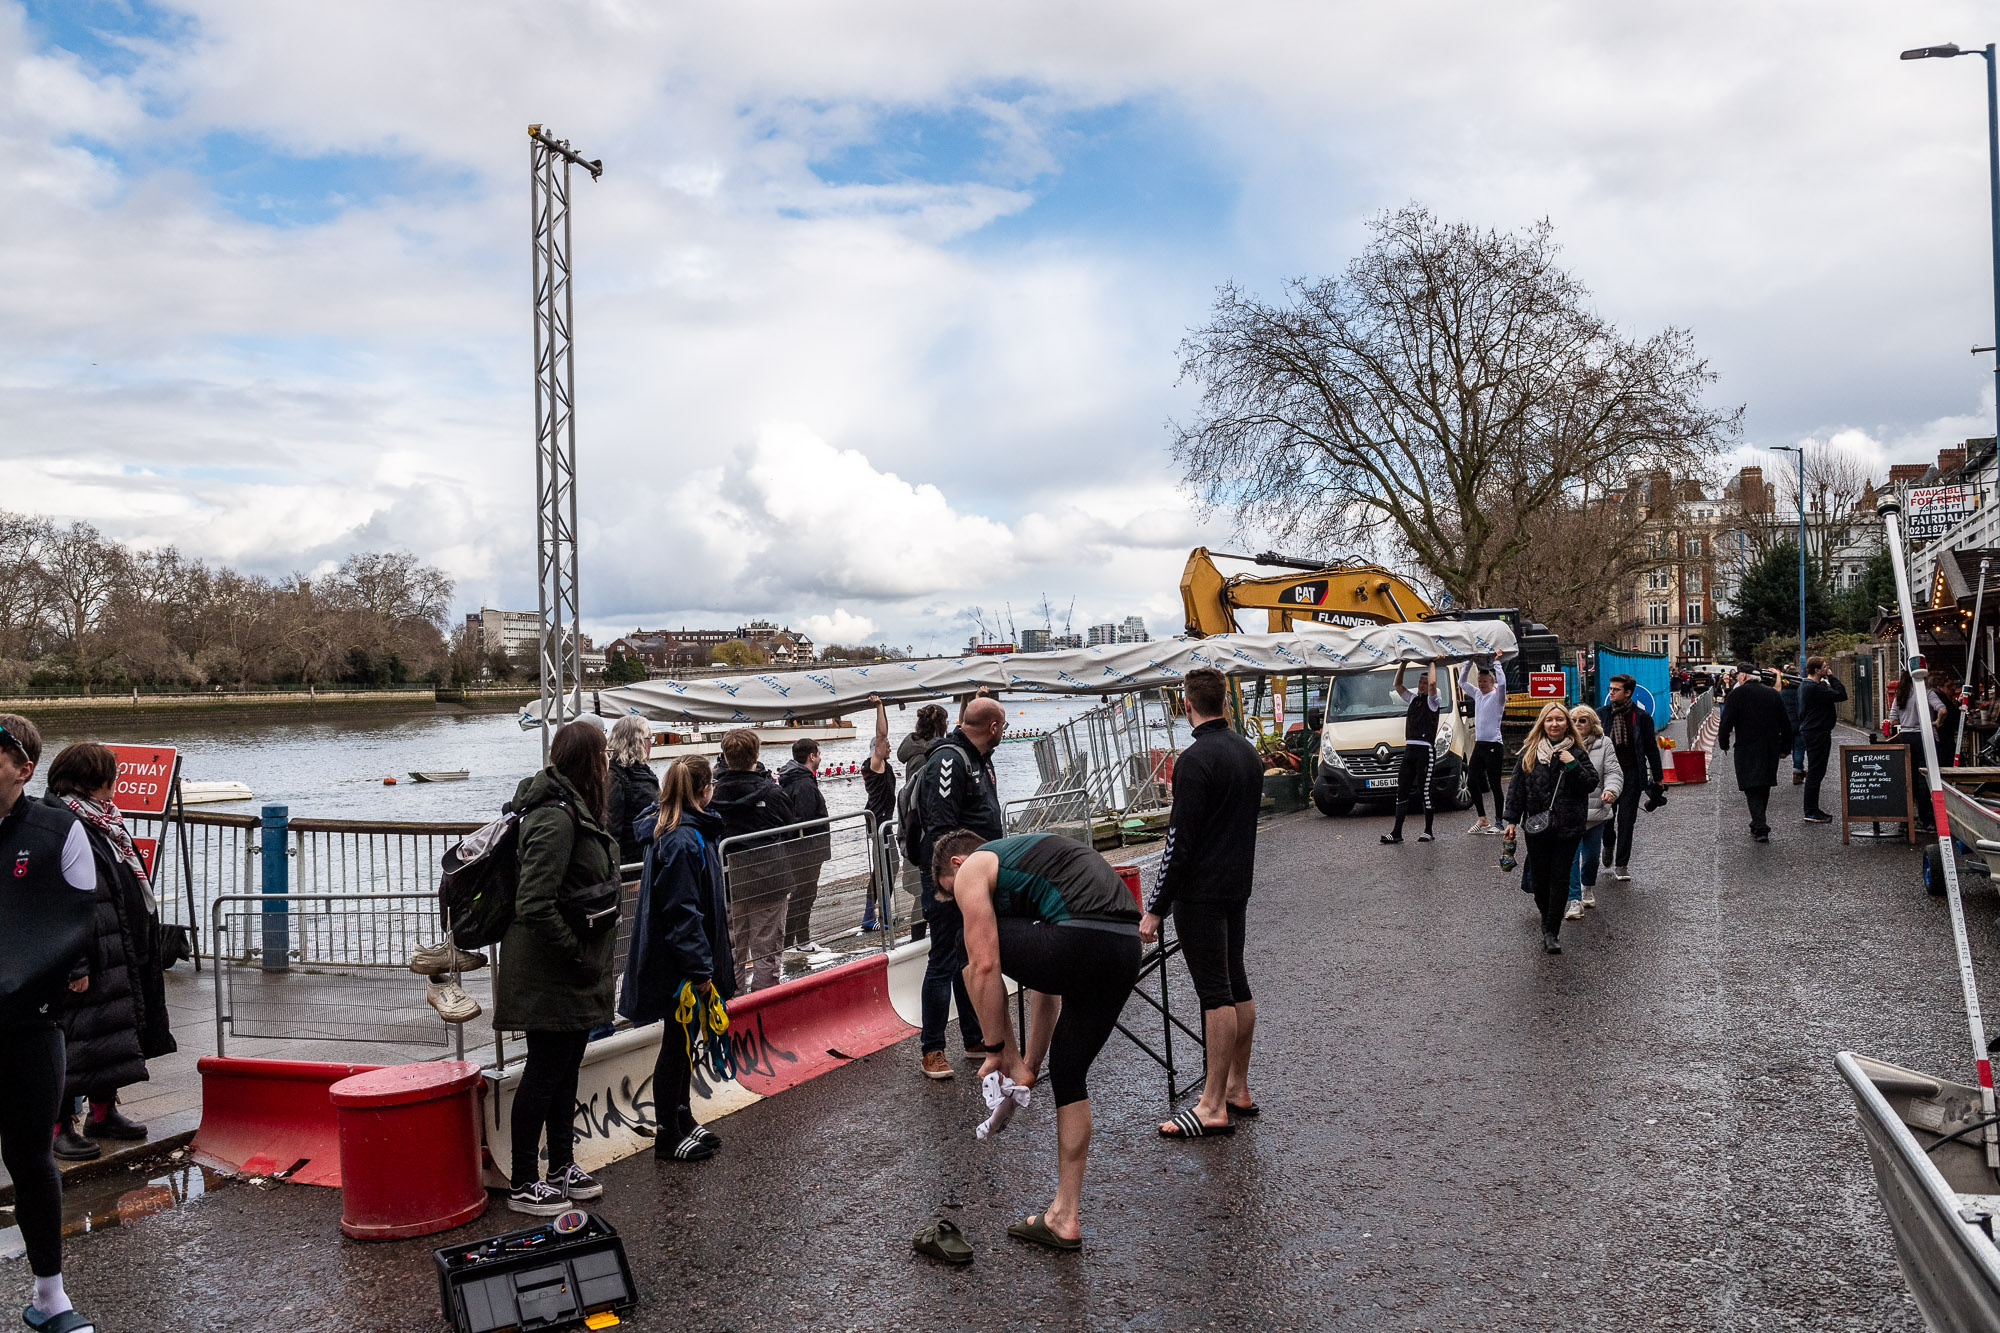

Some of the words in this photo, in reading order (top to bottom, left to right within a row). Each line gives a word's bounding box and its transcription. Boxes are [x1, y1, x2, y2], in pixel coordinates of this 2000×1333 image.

[1913, 486, 1966, 497] AVAILABLE
[1910, 497, 1934, 506] FOR
[1937, 494, 1967, 504] RENT
[1295, 586, 1316, 603] CAT
[1541, 664, 1556, 672] CAT
[1852, 754, 1891, 763] ENTRANCE
[120, 762, 167, 777] OTWAY
[117, 781, 158, 795] OSED
[1952, 897, 1961, 912] NOT
[1960, 941, 1969, 960] HERE
